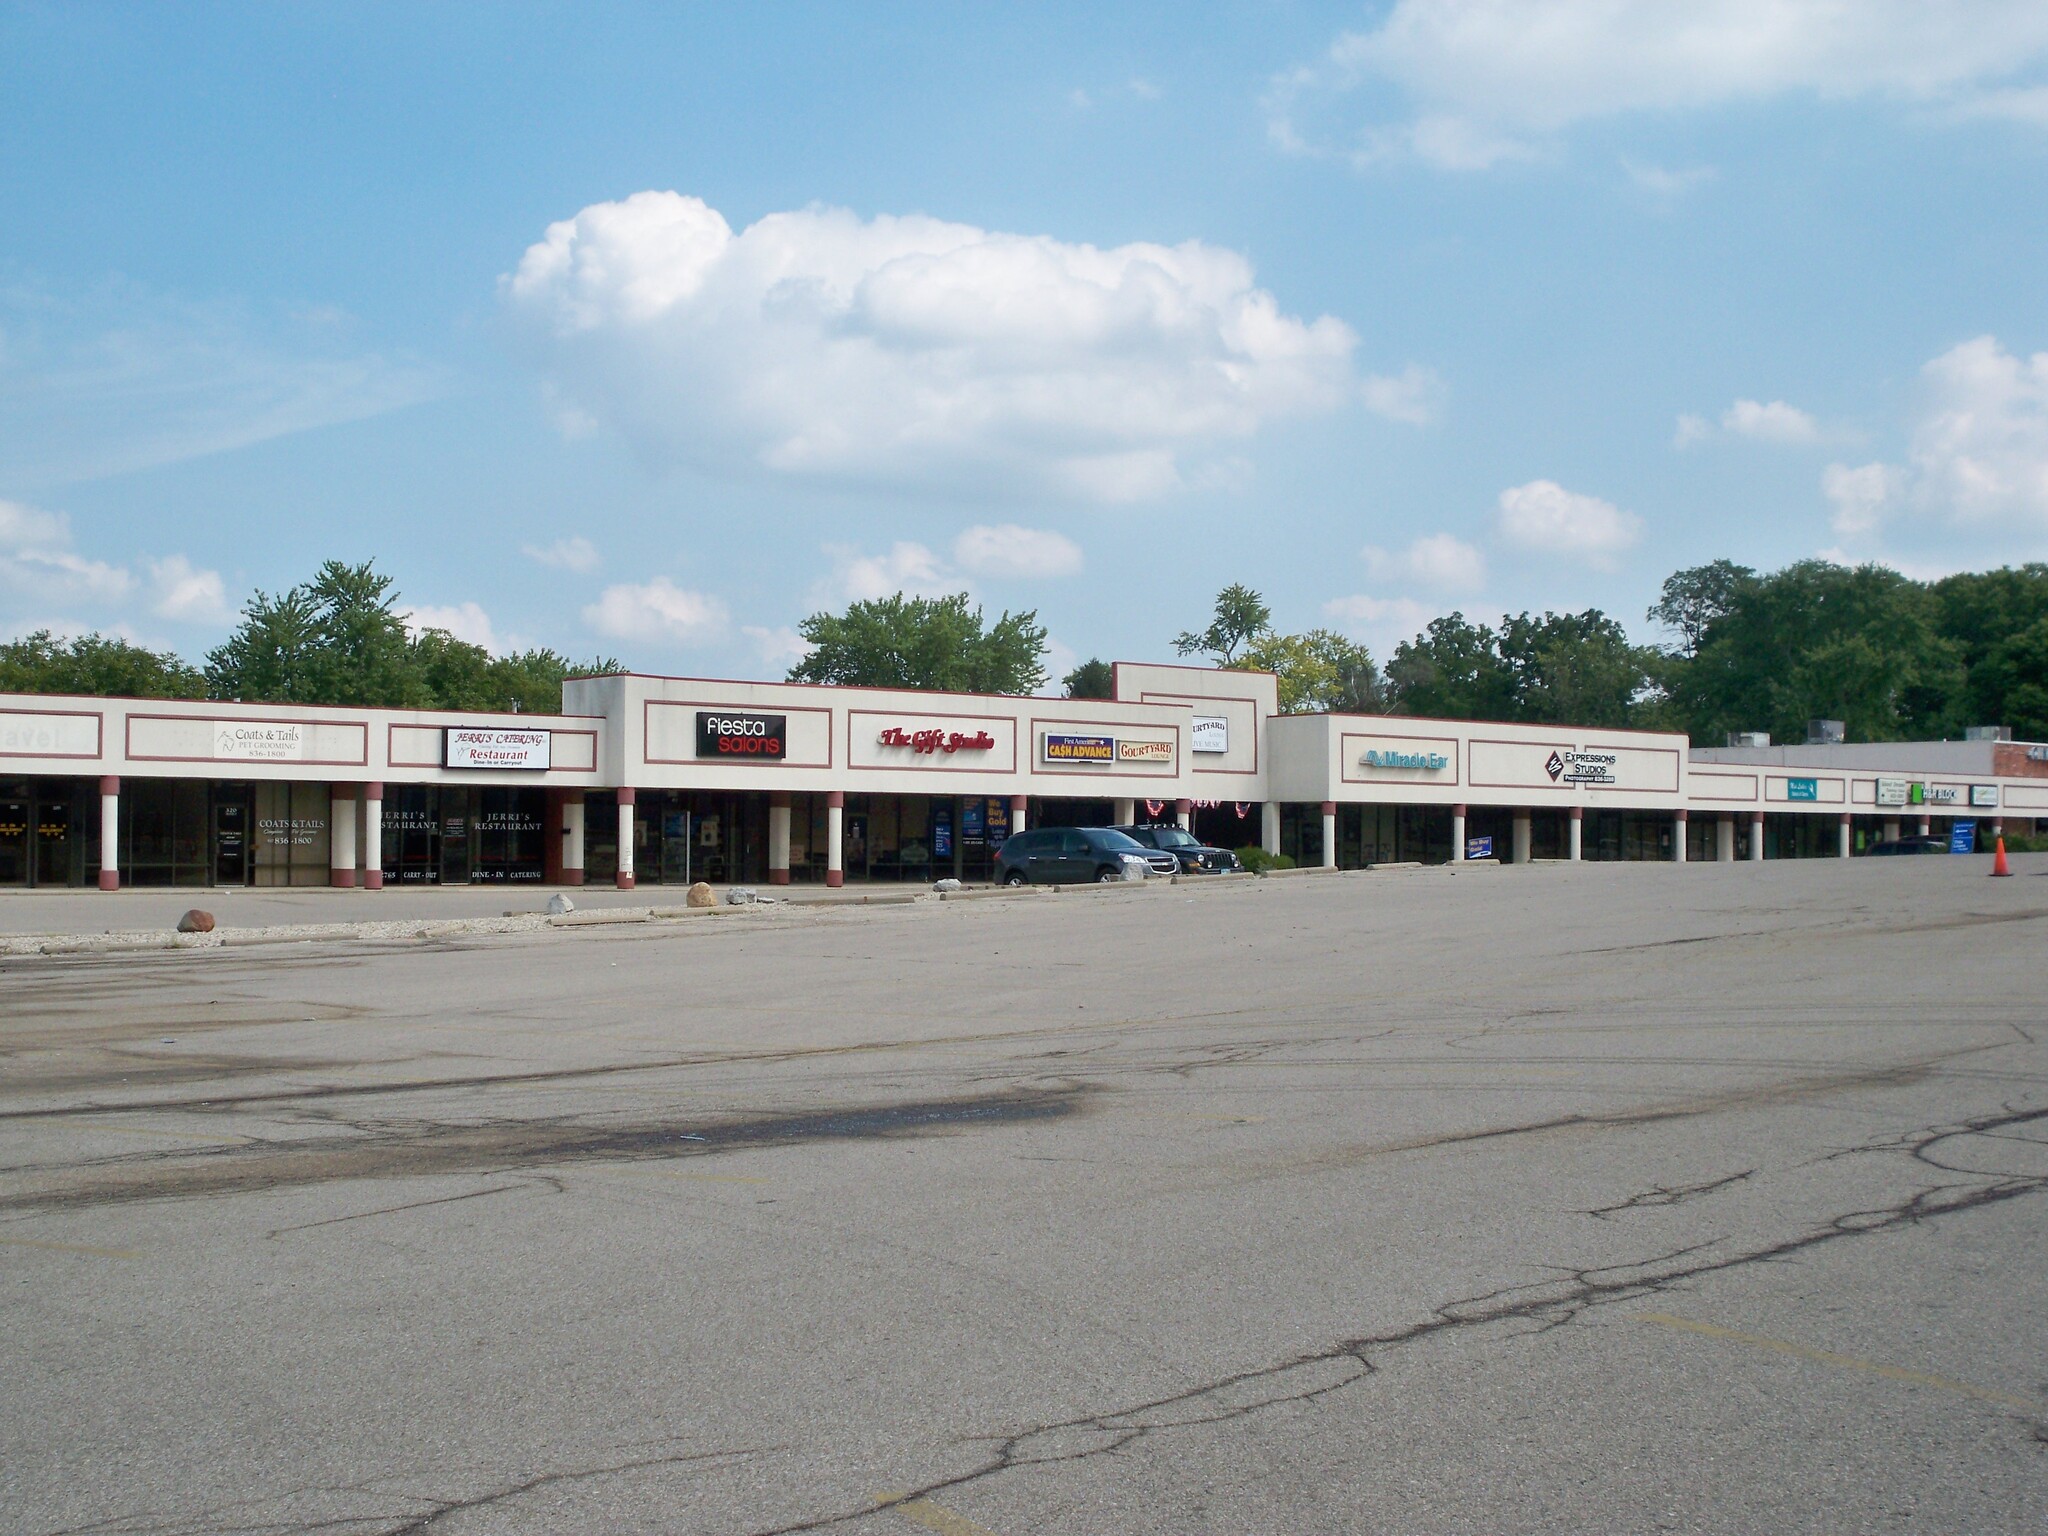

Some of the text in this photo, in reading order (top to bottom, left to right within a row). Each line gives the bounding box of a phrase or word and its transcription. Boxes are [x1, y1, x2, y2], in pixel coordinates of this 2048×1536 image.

[707, 717, 765, 736] fiesta
[235, 726, 299, 741] Coats & Tails
[454, 732, 544, 746] JERRI'S CATERING
[879, 727, 995, 754] The Gift Studio
[238, 741, 296, 750] PET GROOMING
[719, 736, 780, 753] salons
[248, 750, 286, 758] 836-1800
[469, 748, 528, 760] Restaurant
[1072, 746, 1112, 758] ADVANCE
[1120, 743, 1172, 758] COURTYARD
[1565, 752, 1616, 764] EXPRESSIONS
[1575, 763, 1607, 774] STUDIOS
[486, 812, 530, 822] JERRI'S
[988, 808, 1003, 818] Buy
[259, 819, 325, 829] COATS & TAILS
[474, 822, 542, 831] RESTAURANT
[988, 817, 1007, 826] Gold
[274, 837, 289, 845] 836
[403, 871, 421, 879] CARRY
[471, 871, 490, 879] DINE
[510, 871, 541, 879] CATERING
